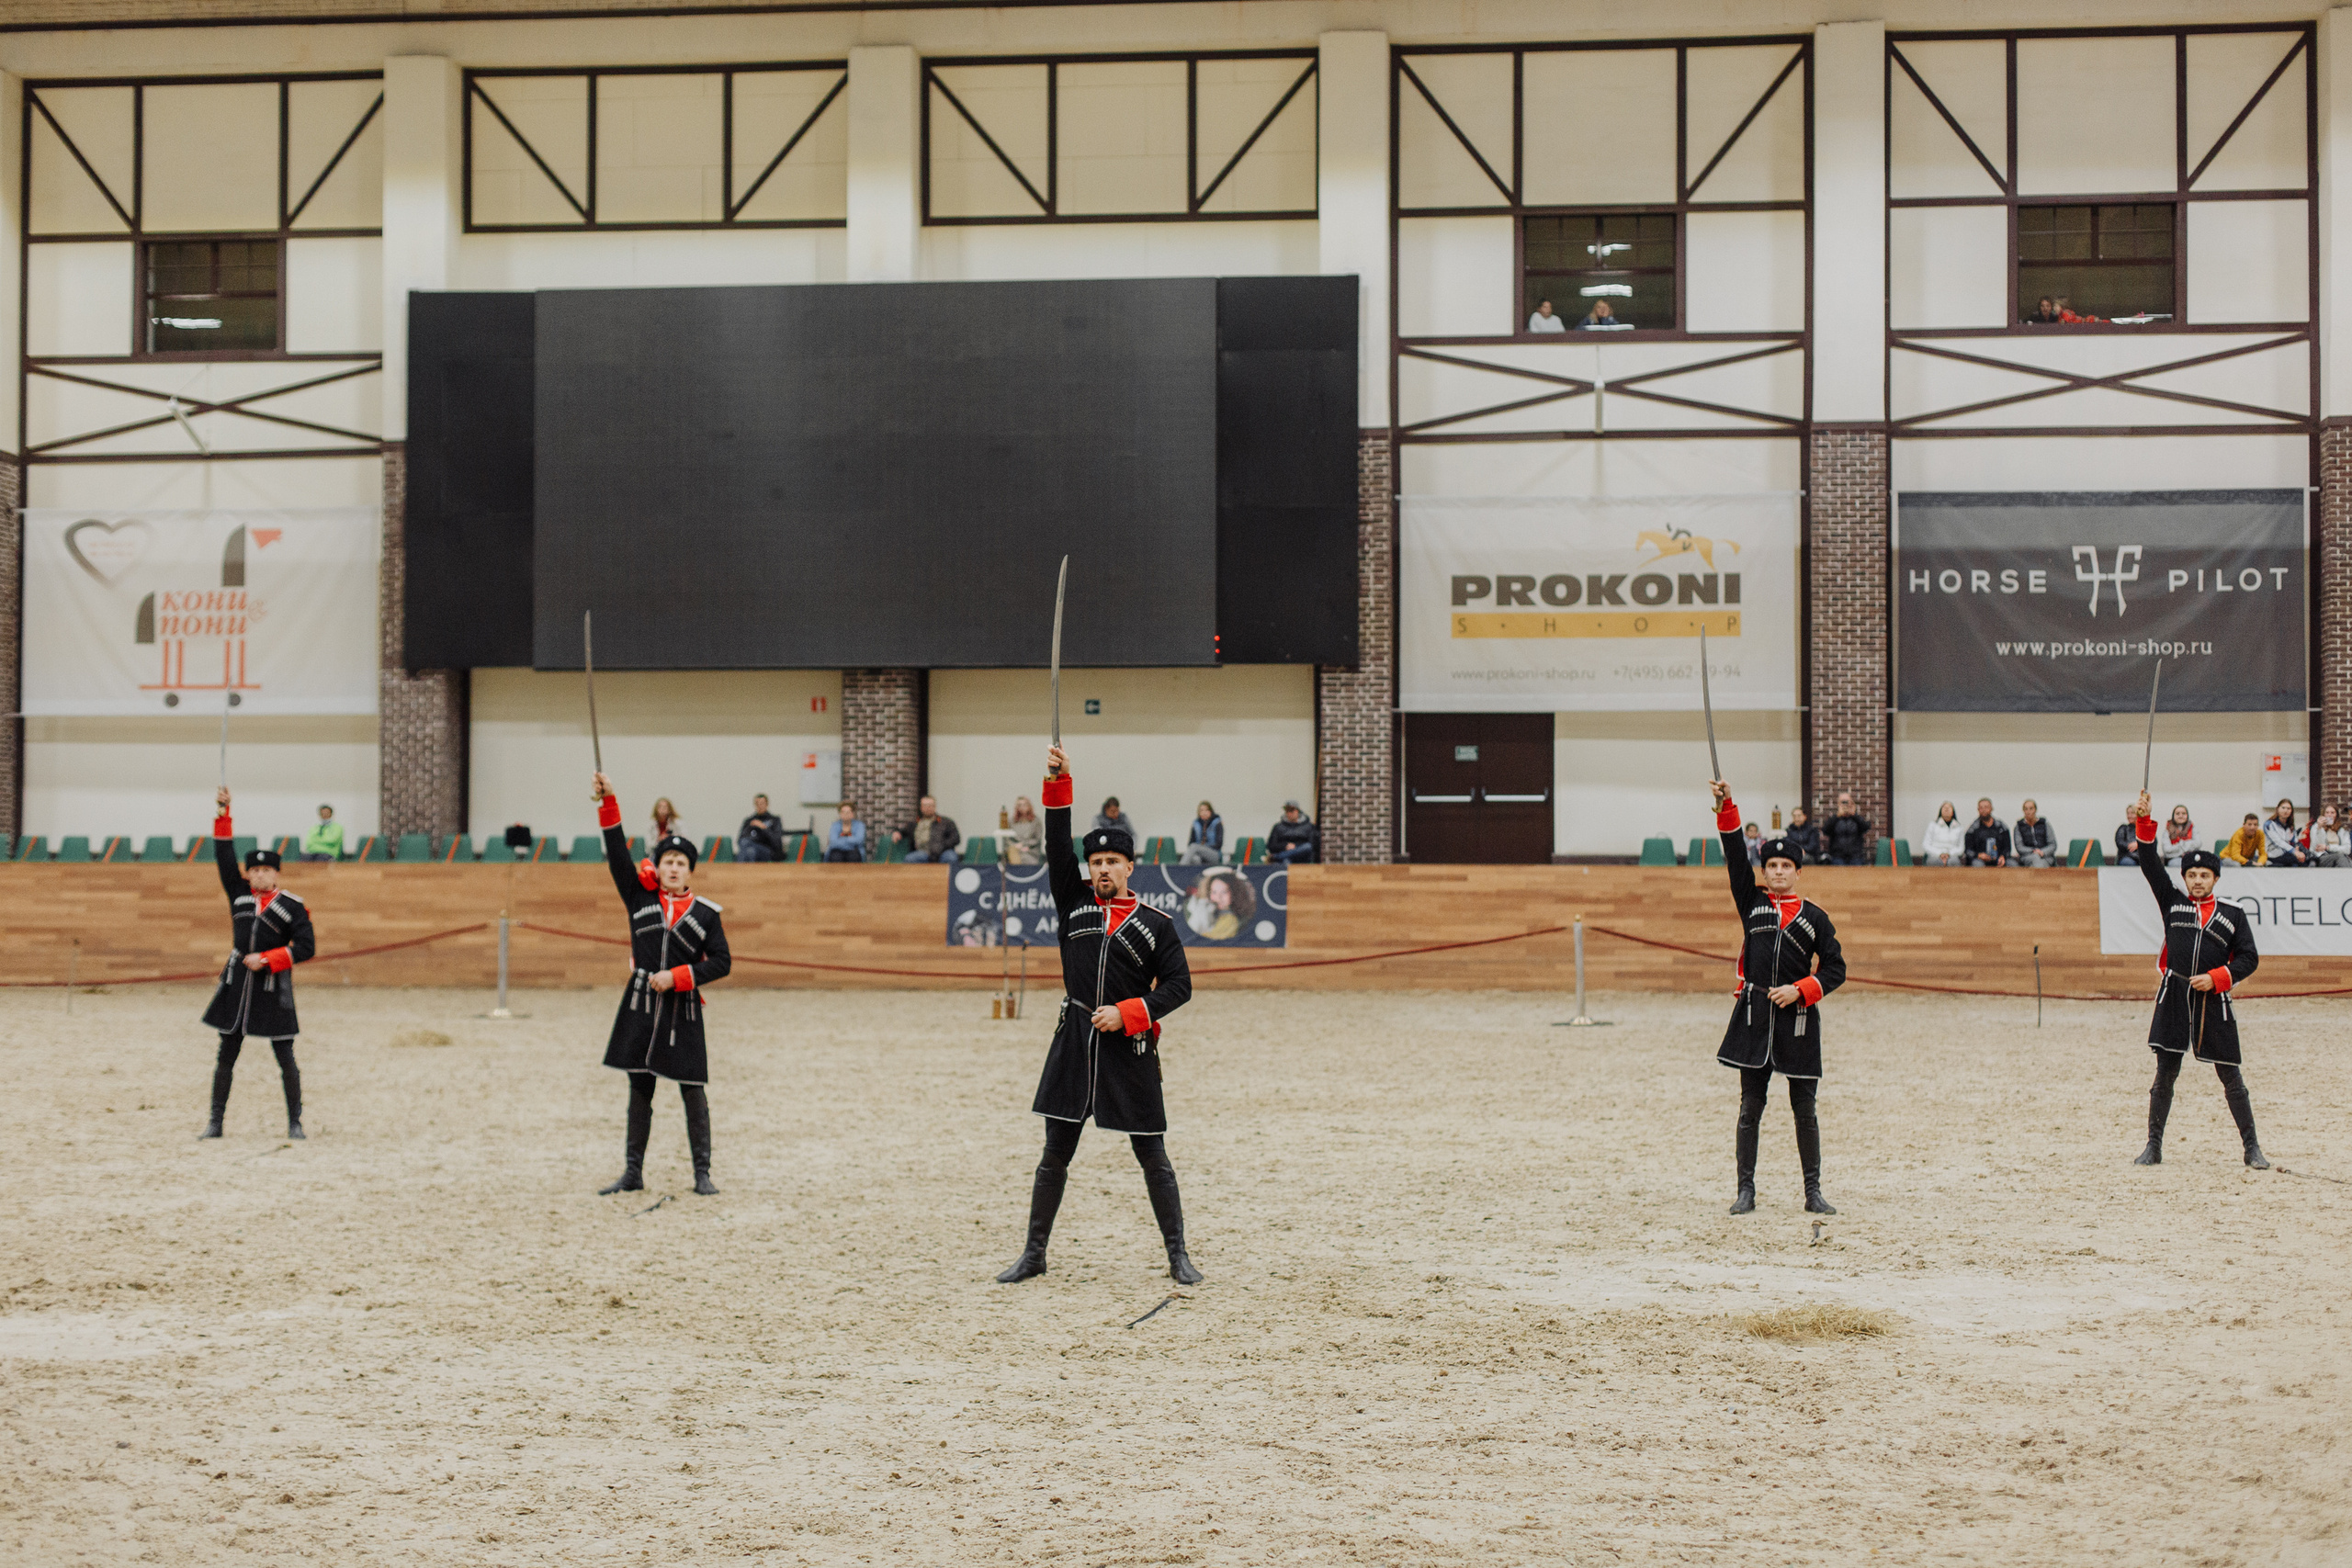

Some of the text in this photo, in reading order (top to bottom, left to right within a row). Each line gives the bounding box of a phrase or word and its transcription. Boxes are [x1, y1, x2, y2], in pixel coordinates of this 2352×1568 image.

[1451, 572, 1742, 606] PROKONI
[1909, 567, 2290, 594] HORSE PILOT
[1996, 638, 2213, 659] www.prokoni-shop.ru
[1451, 667, 1596, 682] www.prokoni-shop.ru
[1667, 664, 1741, 680] 662-9-94
